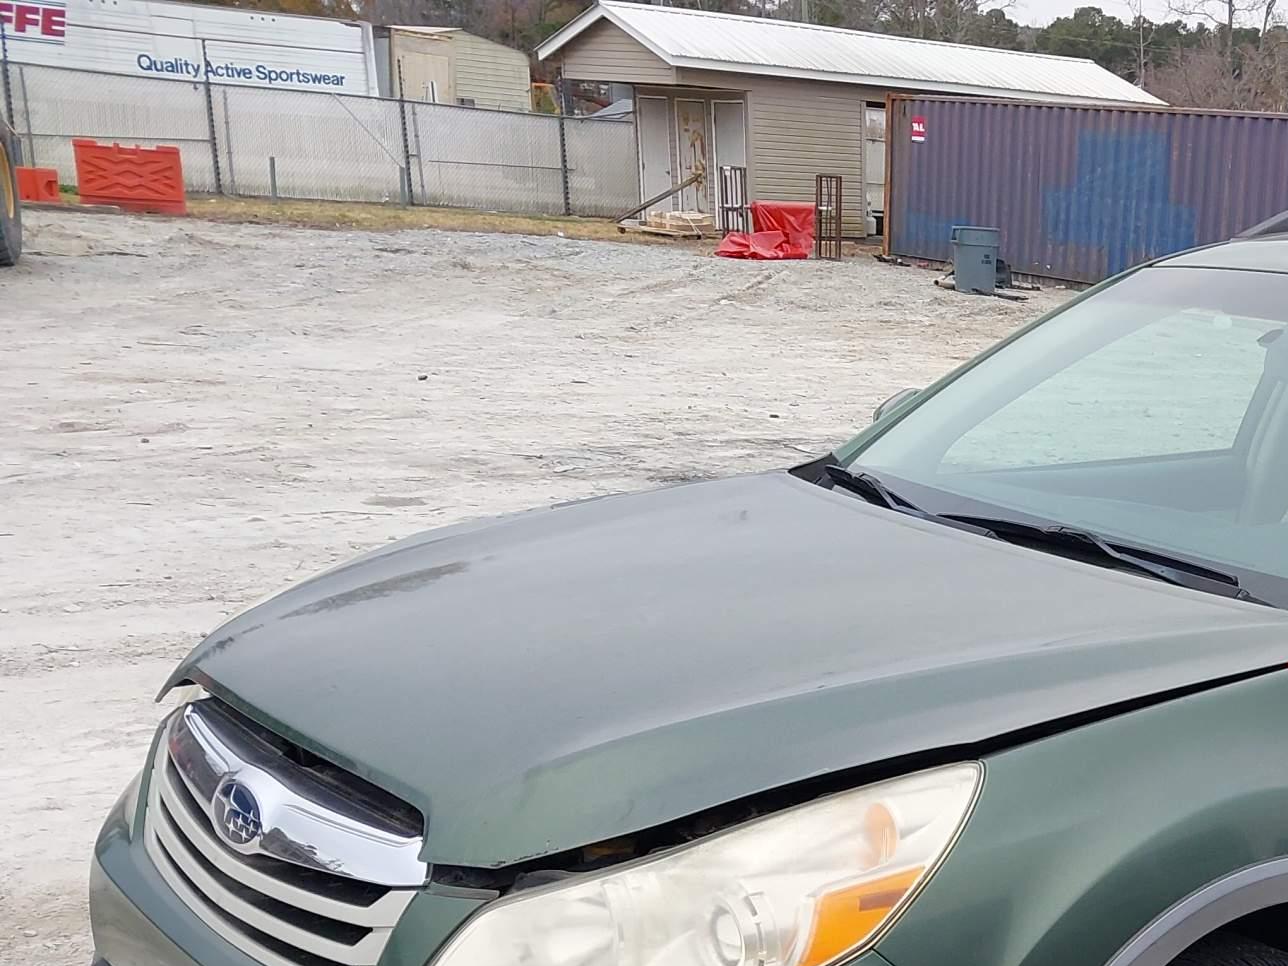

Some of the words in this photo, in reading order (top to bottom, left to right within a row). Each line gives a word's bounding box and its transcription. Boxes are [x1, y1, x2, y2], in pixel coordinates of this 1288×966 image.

[137, 54, 200, 77] Quality
[204, 59, 252, 79] Active
[255, 65, 345, 86] Sportswear
